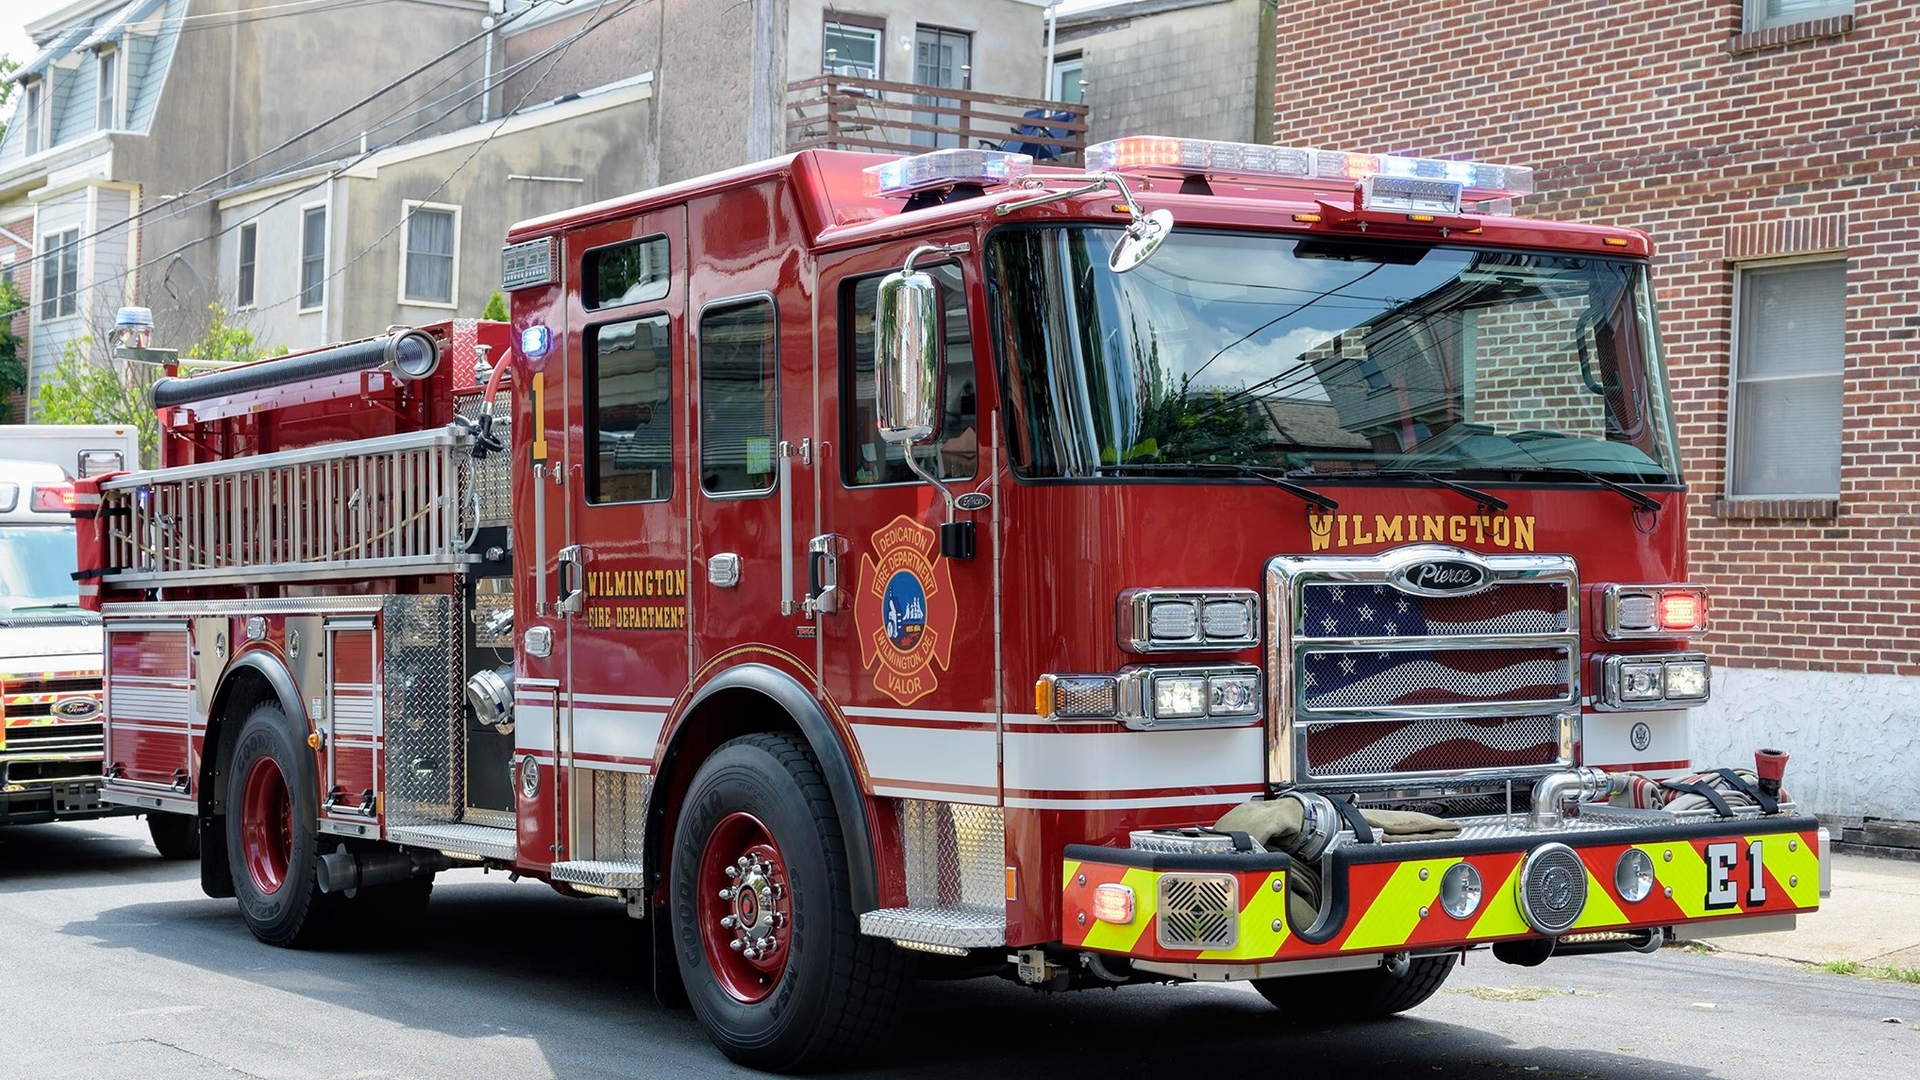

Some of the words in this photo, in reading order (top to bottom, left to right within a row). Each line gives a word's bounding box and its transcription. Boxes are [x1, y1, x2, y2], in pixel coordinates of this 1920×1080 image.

[529, 371, 548, 464] 1
[879, 526, 928, 553] DEDICATION
[1308, 514, 1536, 552] WILMINGTON
[587, 569, 686, 598] WILMINGTON
[874, 568, 889, 594] FIRE
[888, 550, 935, 592] DEPARTMENT
[1417, 563, 1473, 588] Pierce
[588, 606, 611, 629] FIRE
[616, 606, 685, 629] DEPARTMENT
[877, 632, 924, 670] WILMINGTON,
[887, 672, 922, 696] VALOR
[66, 702, 90, 714] Ford
[679, 789, 724, 968] GOODYEAR
[1704, 840, 1766, 911] E1
